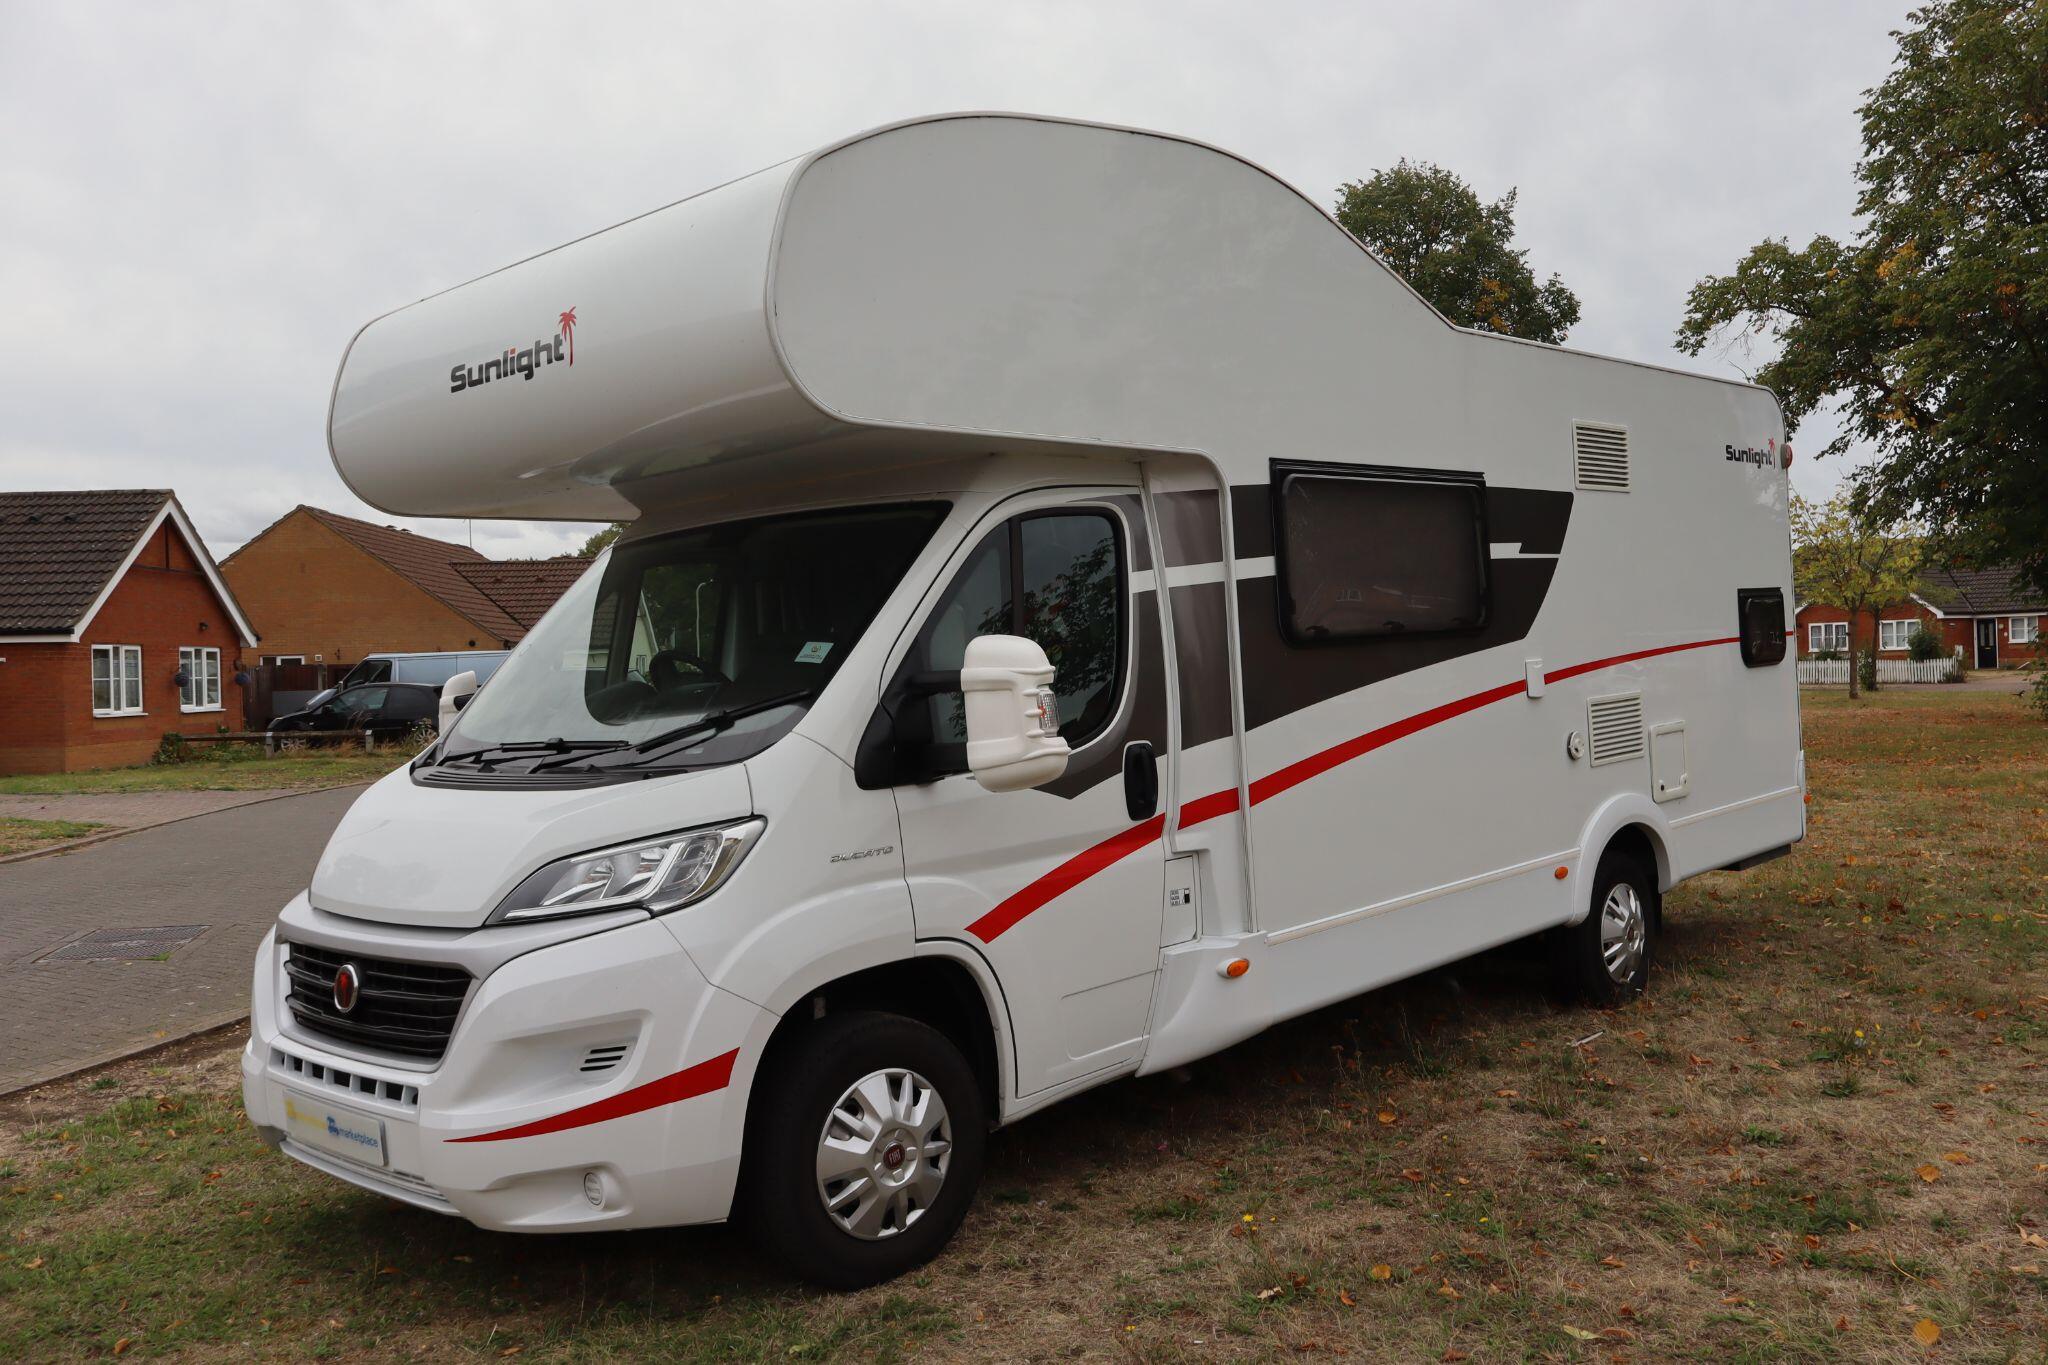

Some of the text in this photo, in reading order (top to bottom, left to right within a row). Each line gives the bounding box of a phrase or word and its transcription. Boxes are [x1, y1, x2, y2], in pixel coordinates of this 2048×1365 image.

[451, 333, 564, 393] Sunlight
[1726, 445, 1772, 469] Sunlight
[830, 845, 894, 863] DUCATO
[888, 1149, 901, 1165] FIAT
